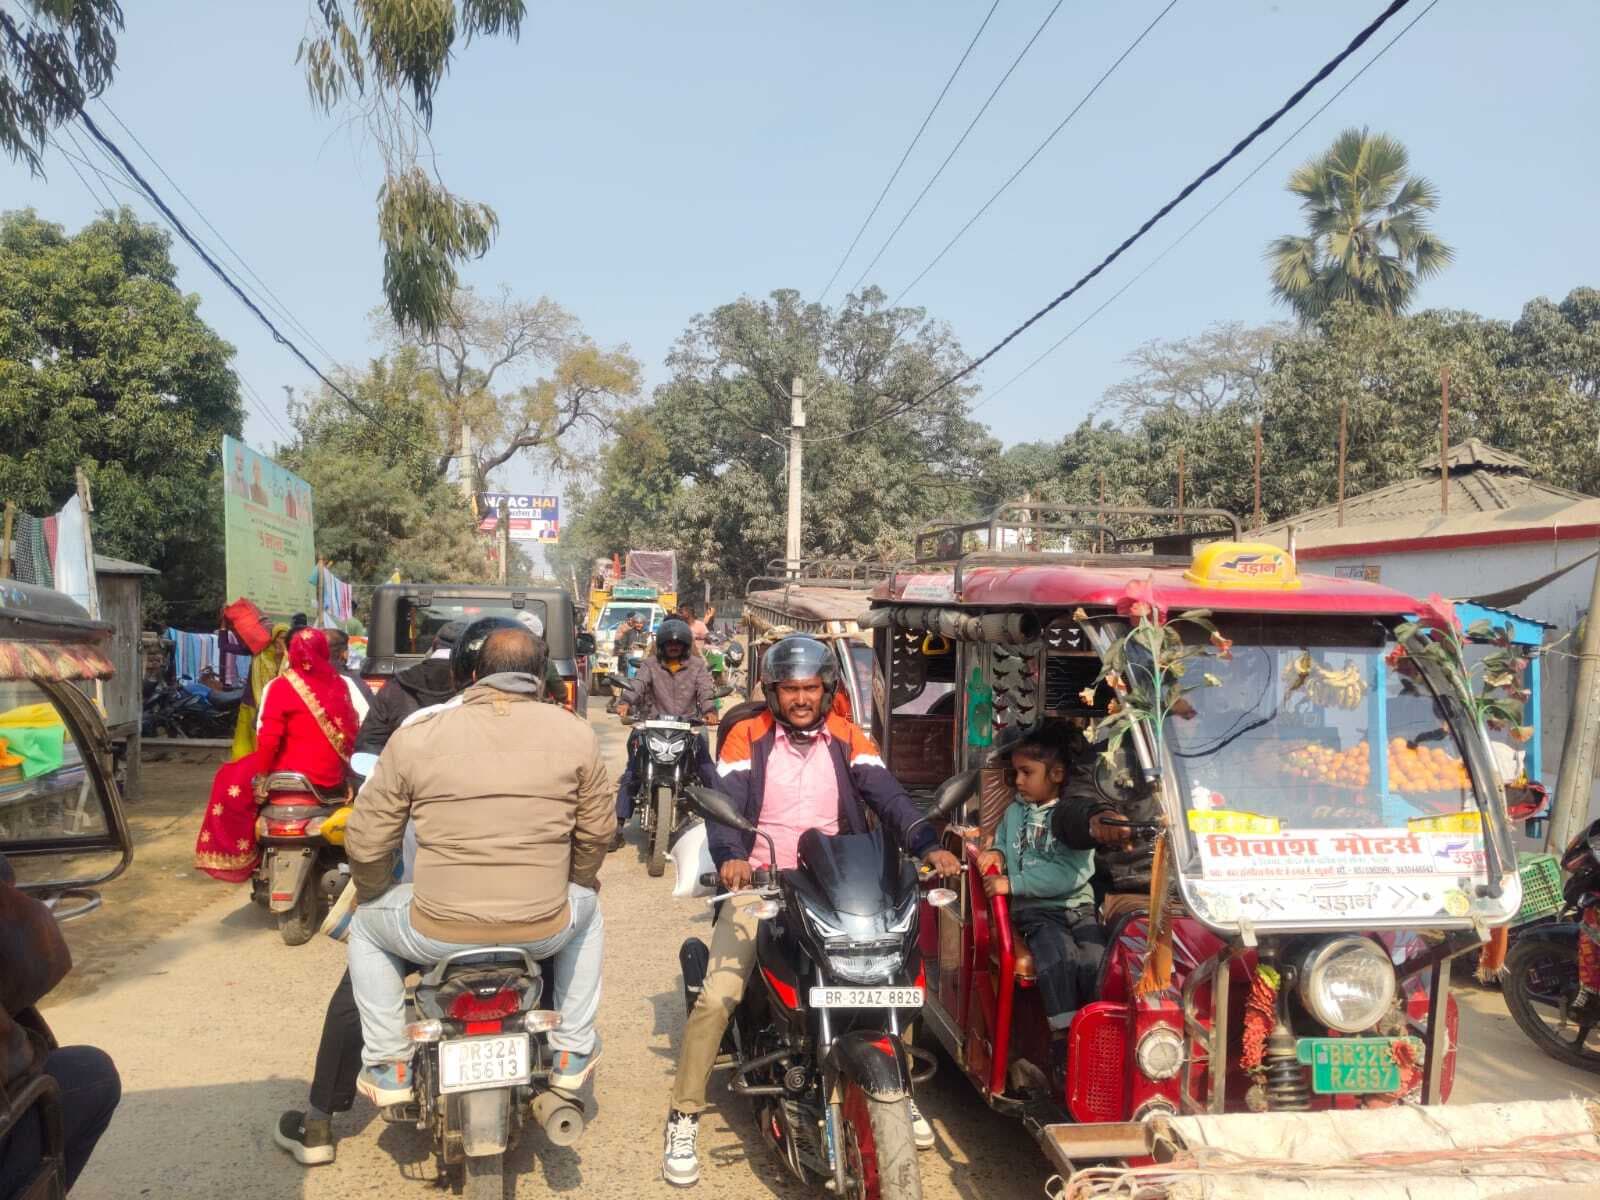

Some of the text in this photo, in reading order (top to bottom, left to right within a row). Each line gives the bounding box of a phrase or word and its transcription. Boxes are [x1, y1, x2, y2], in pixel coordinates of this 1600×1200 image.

[532, 498, 556, 509] HAI
[1236, 562, 1277, 576] उड़ान
[1205, 830, 1423, 857] शिवांश मोटर्स
[825, 991, 920, 1004] BR 32AZ 8826
[1330, 1067, 1393, 1090] R4697
